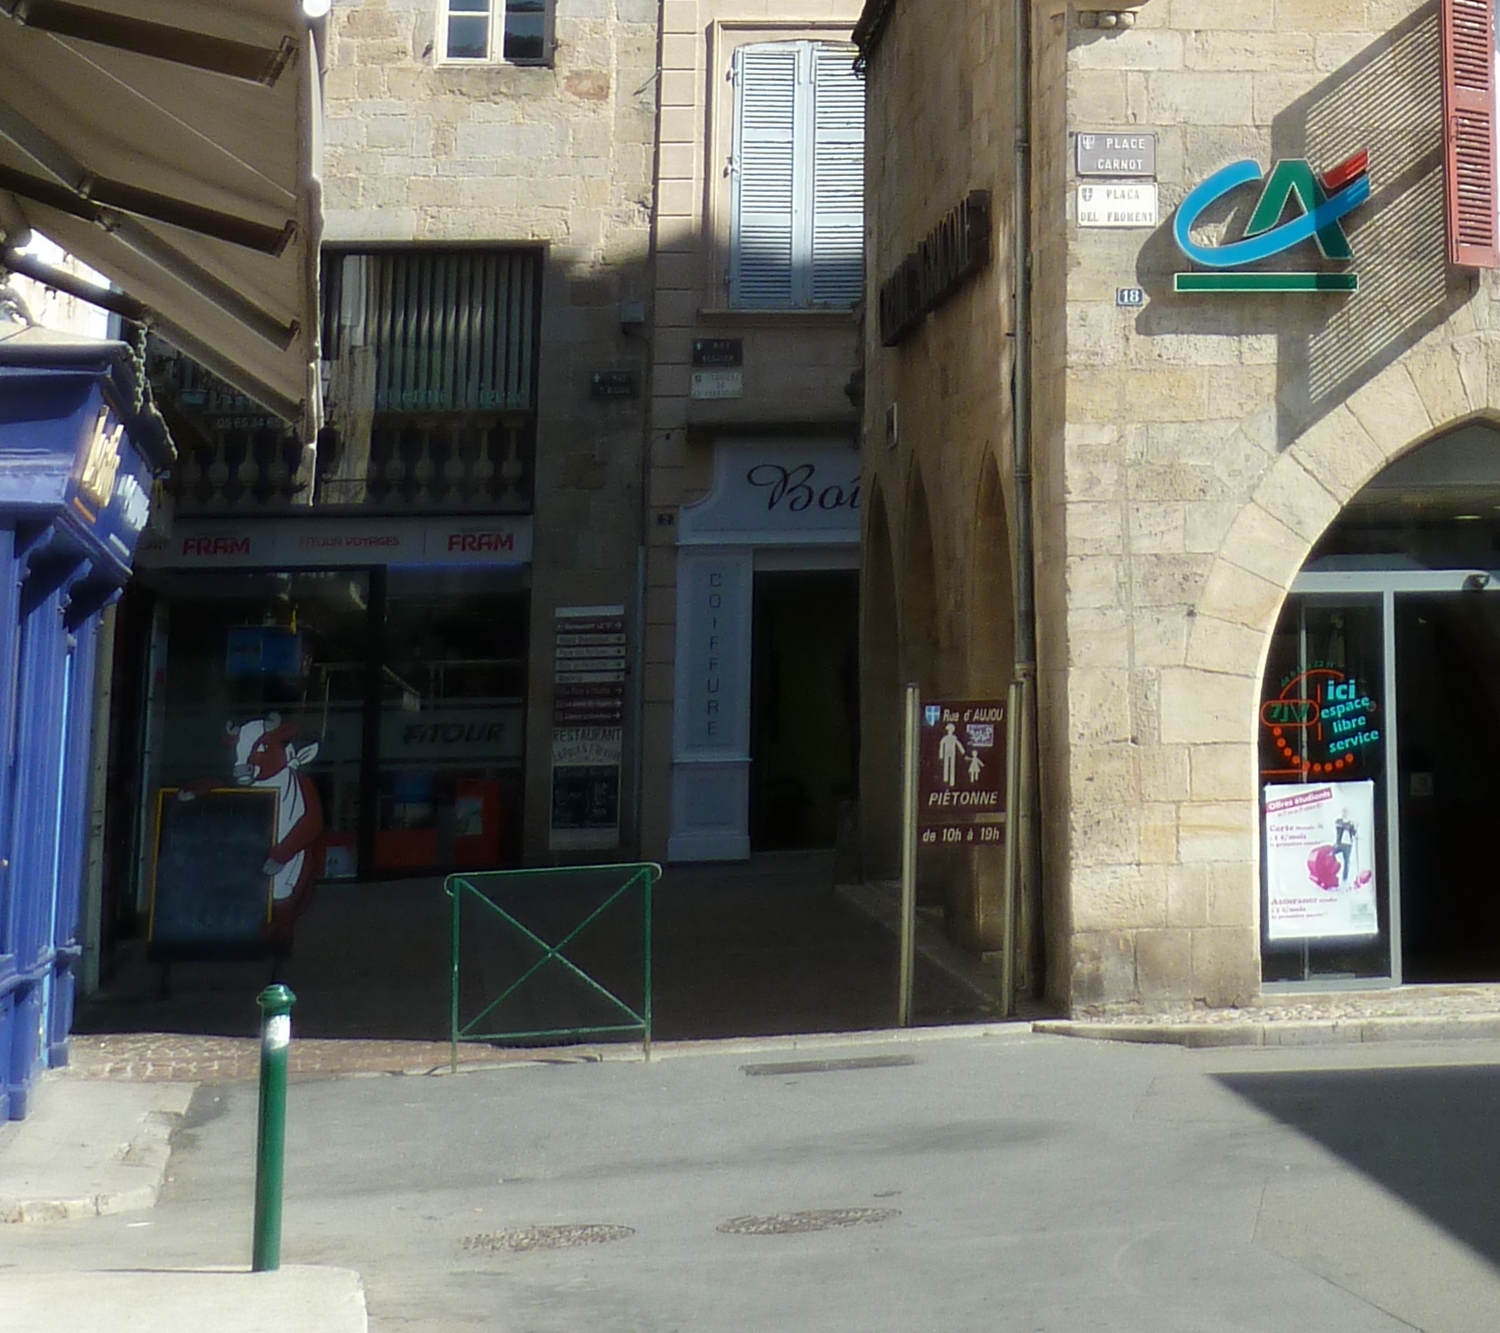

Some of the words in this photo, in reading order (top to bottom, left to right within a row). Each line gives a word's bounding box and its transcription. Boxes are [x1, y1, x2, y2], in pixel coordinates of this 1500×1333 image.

[1106, 137, 1145, 150] PLACE
[1097, 158, 1143, 170] CARNOT
[1080, 211, 1099, 222] DEL
[1107, 211, 1153, 222] FROMENT
[1122, 289, 1139, 302] 18
[182, 536, 251, 555] FRAM
[346, 537, 399, 547] VOYAGES
[448, 534, 513, 552] FRAM
[707, 573, 722, 735] COIFFURE
[1327, 679, 1356, 700] ici
[1321, 696, 1371, 719] espace
[943, 709, 959, 722] Rue
[1332, 715, 1366, 734] libre
[553, 728, 621, 741] RESTAURANT
[1329, 729, 1380, 753] service
[928, 789, 998, 806] PIÉTONNE
[1268, 798, 1293, 811] Offres
[923, 828, 936, 842] de
[942, 827, 961, 841] 10h
[966, 827, 973, 841] à
[980, 827, 999, 841] 19h
[1269, 824, 1294, 832] Carte
